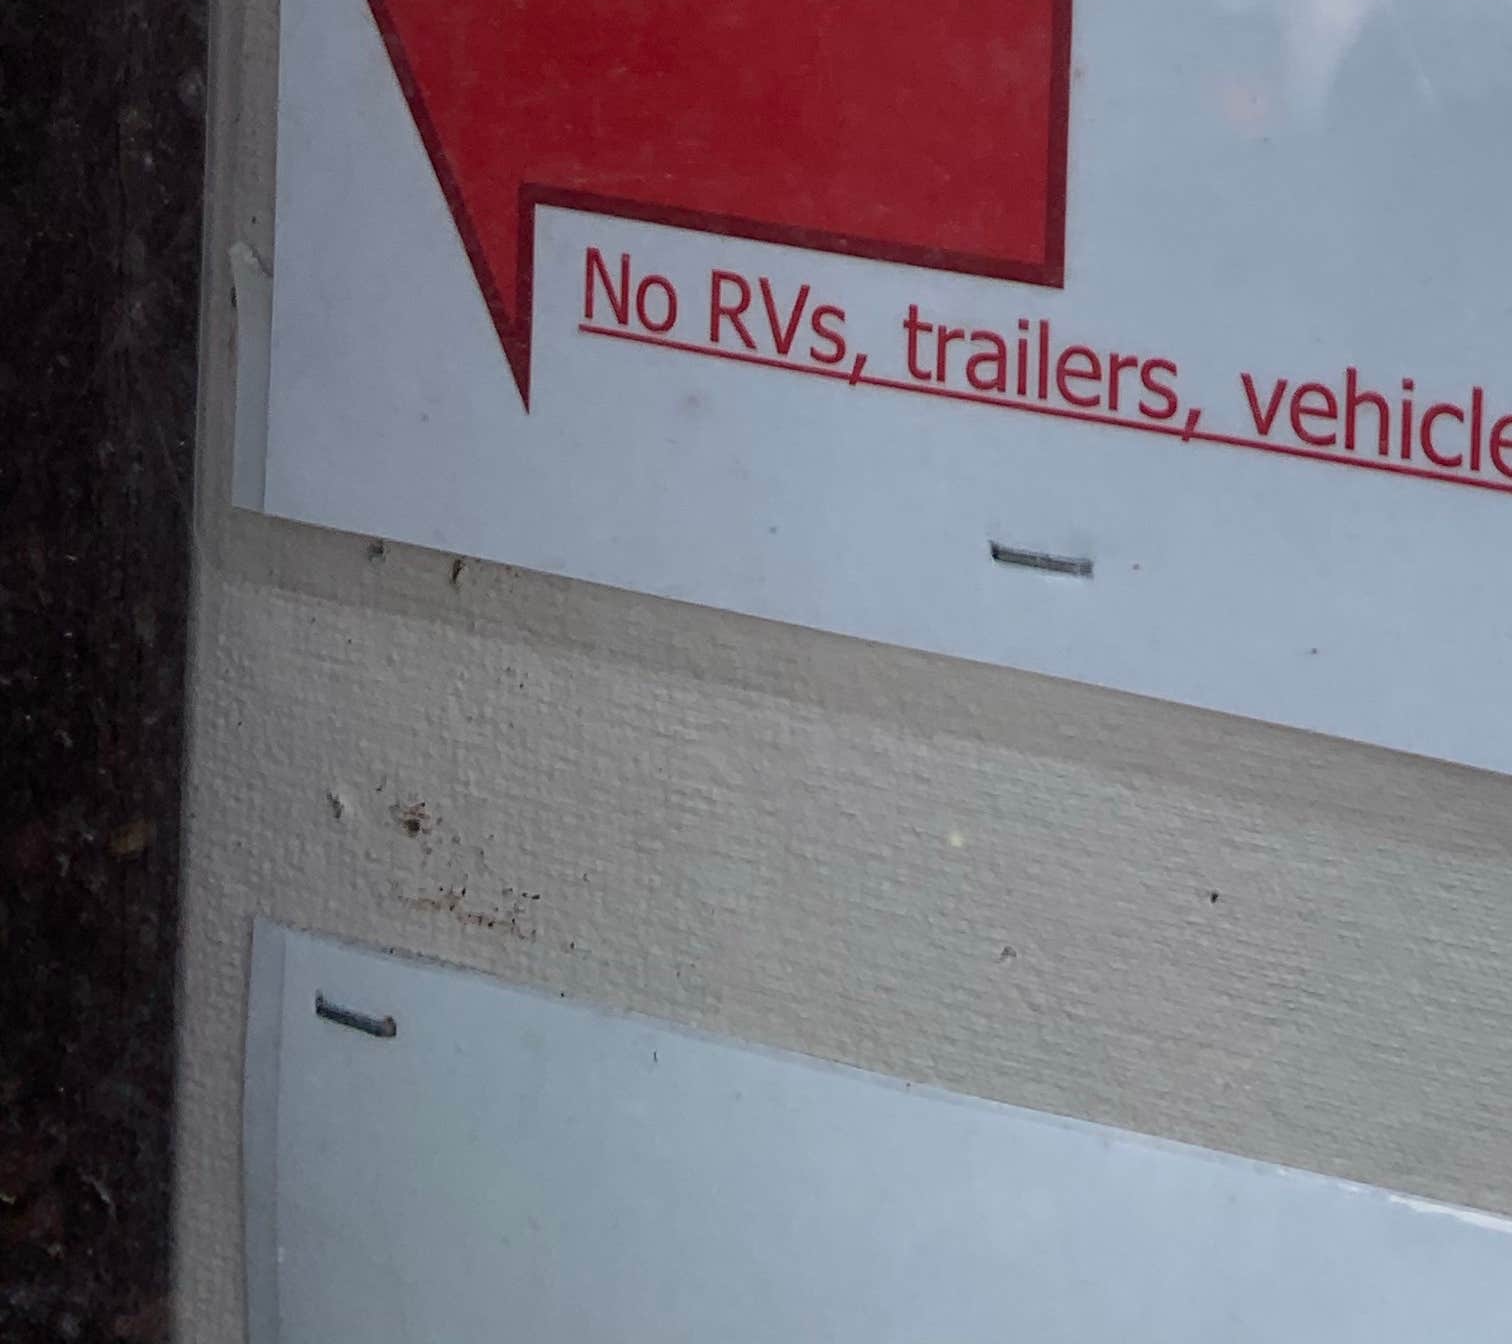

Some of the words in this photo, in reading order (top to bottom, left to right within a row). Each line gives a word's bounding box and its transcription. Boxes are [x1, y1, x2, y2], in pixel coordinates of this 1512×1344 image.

[581, 247, 678, 332] No
[709, 268, 868, 386] RVs,
[903, 303, 1204, 440] trailers,
